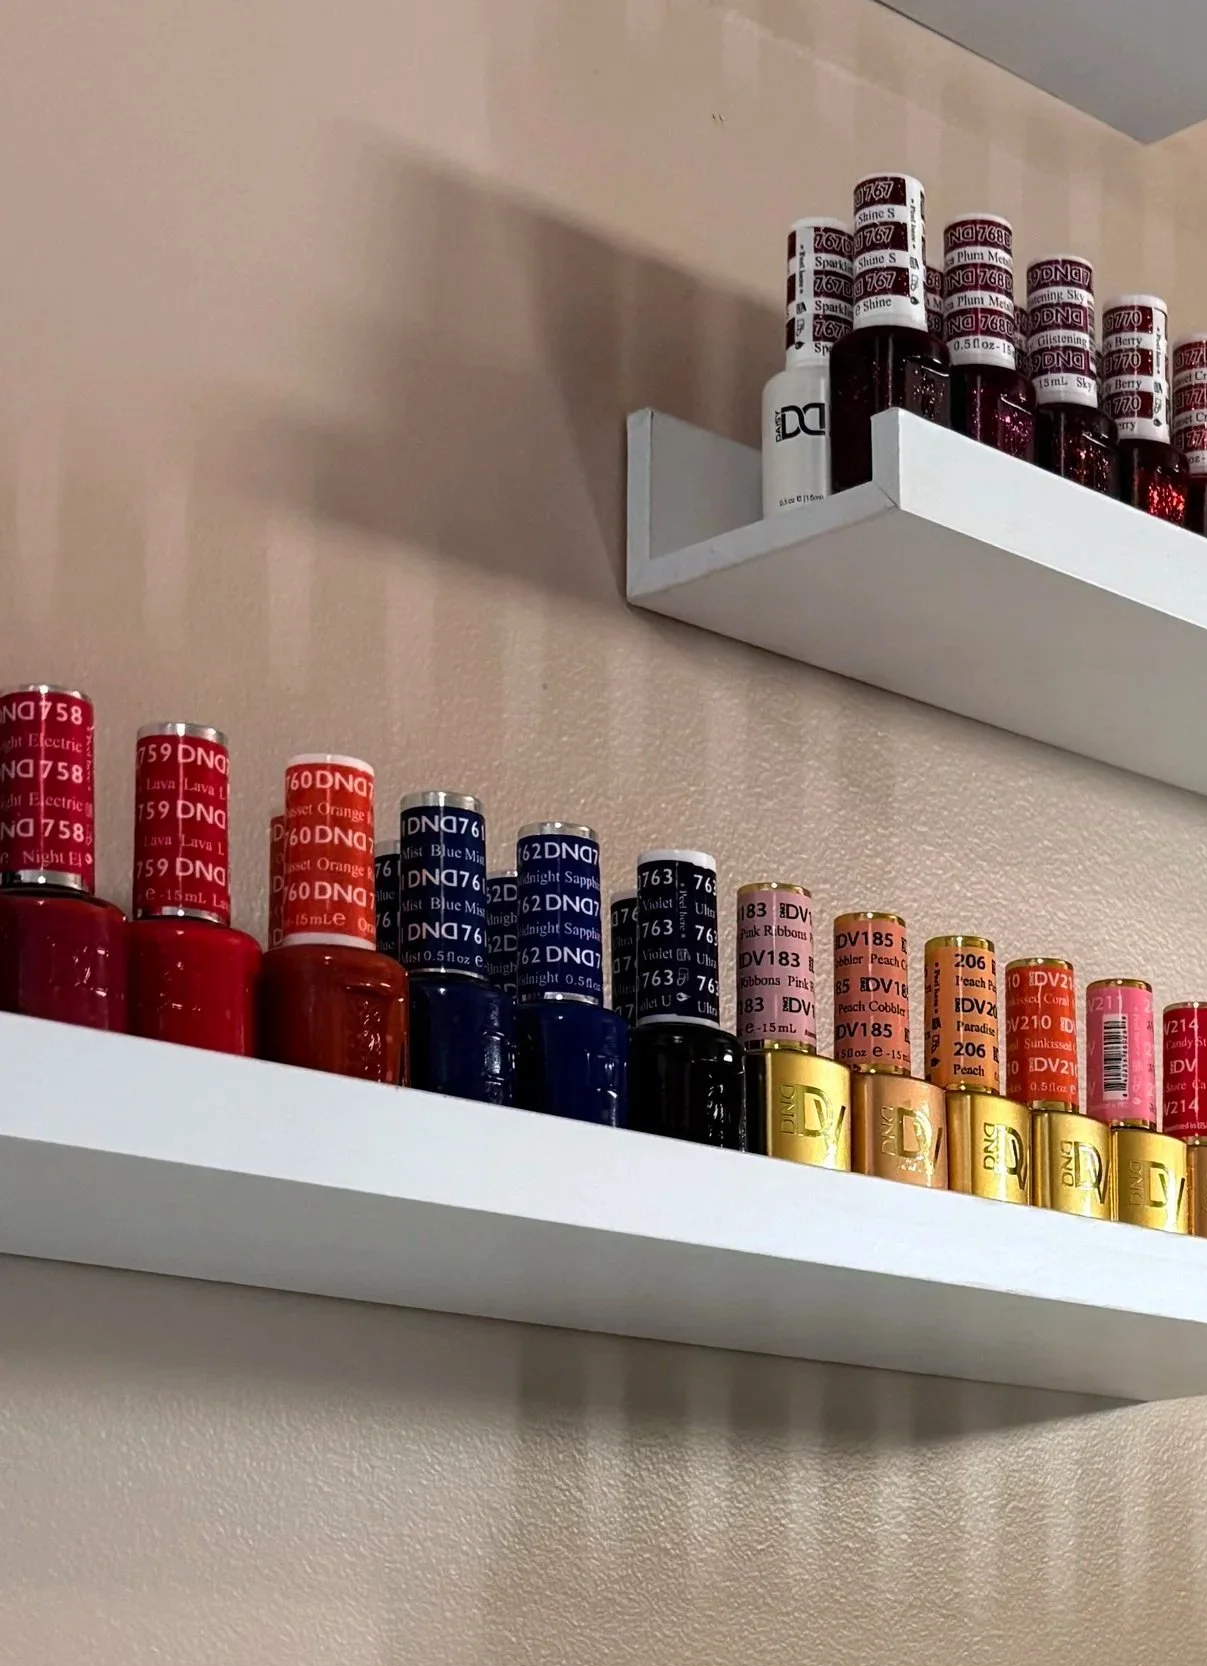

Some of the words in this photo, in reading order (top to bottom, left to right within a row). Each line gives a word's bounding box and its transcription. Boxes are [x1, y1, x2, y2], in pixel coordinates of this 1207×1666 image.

[28, 733, 82, 752] Electric
[40, 761, 83, 783] 758
[184, 778, 214, 796] Lava
[29, 792, 83, 812] Electric
[317, 803, 365, 822] Orange
[42, 819, 84, 842] 758
[181, 835, 212, 852] Lava
[431, 844, 461, 858] Blue
[317, 858, 364, 877] Orange
[642, 868, 673, 887] 763
[431, 897, 461, 911] Blue
[642, 919, 674, 938] 763
[764, 925, 807, 941] Ribbons
[870, 954, 900, 968] Peach
[954, 953, 986, 969] 206
[643, 970, 674, 988] 763
[788, 976, 809, 989] Pink
[955, 975, 986, 987] Peach
[953, 1042, 986, 1058] 206
[953, 1064, 985, 1077] Peach
